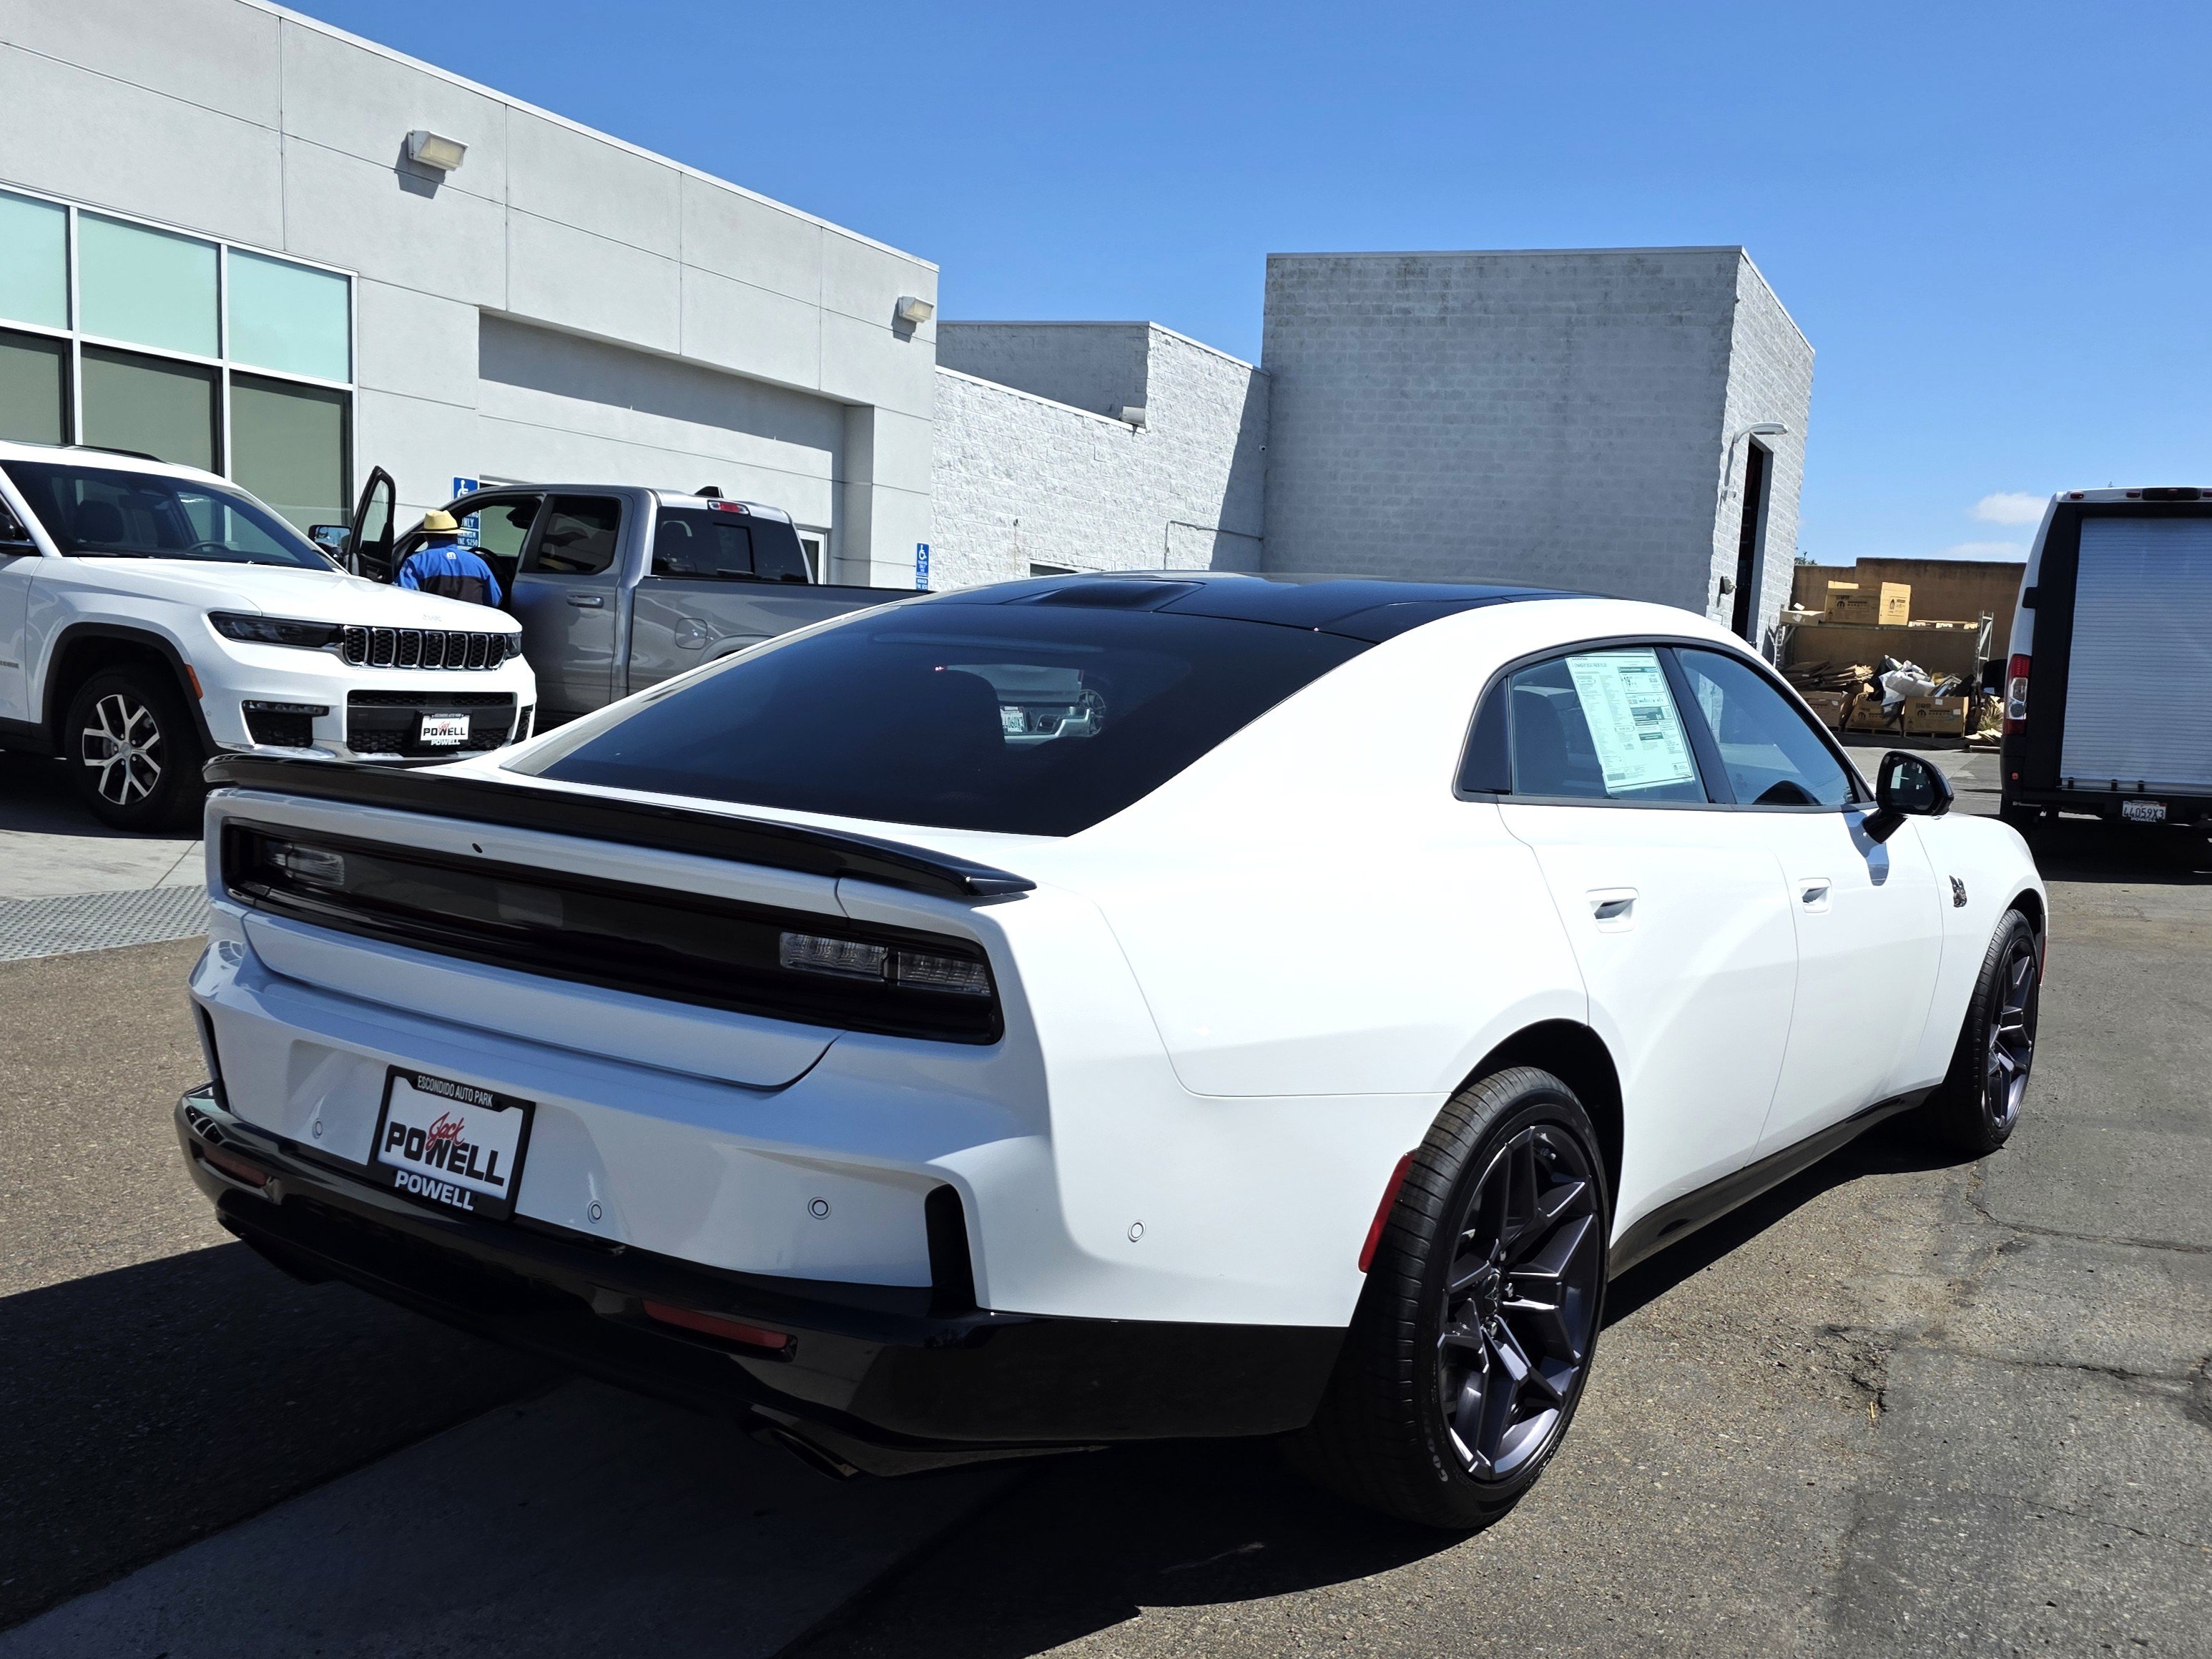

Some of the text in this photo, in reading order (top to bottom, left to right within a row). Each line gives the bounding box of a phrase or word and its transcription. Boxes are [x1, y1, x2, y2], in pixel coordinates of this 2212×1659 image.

[423, 727, 466, 736] POWELL
[418, 1075, 493, 1107] ESCONDIDO AUTO PARK
[425, 1111, 466, 1151] Jack
[385, 1121, 505, 1187] POWELL
[394, 1170, 474, 1211] POWELL
